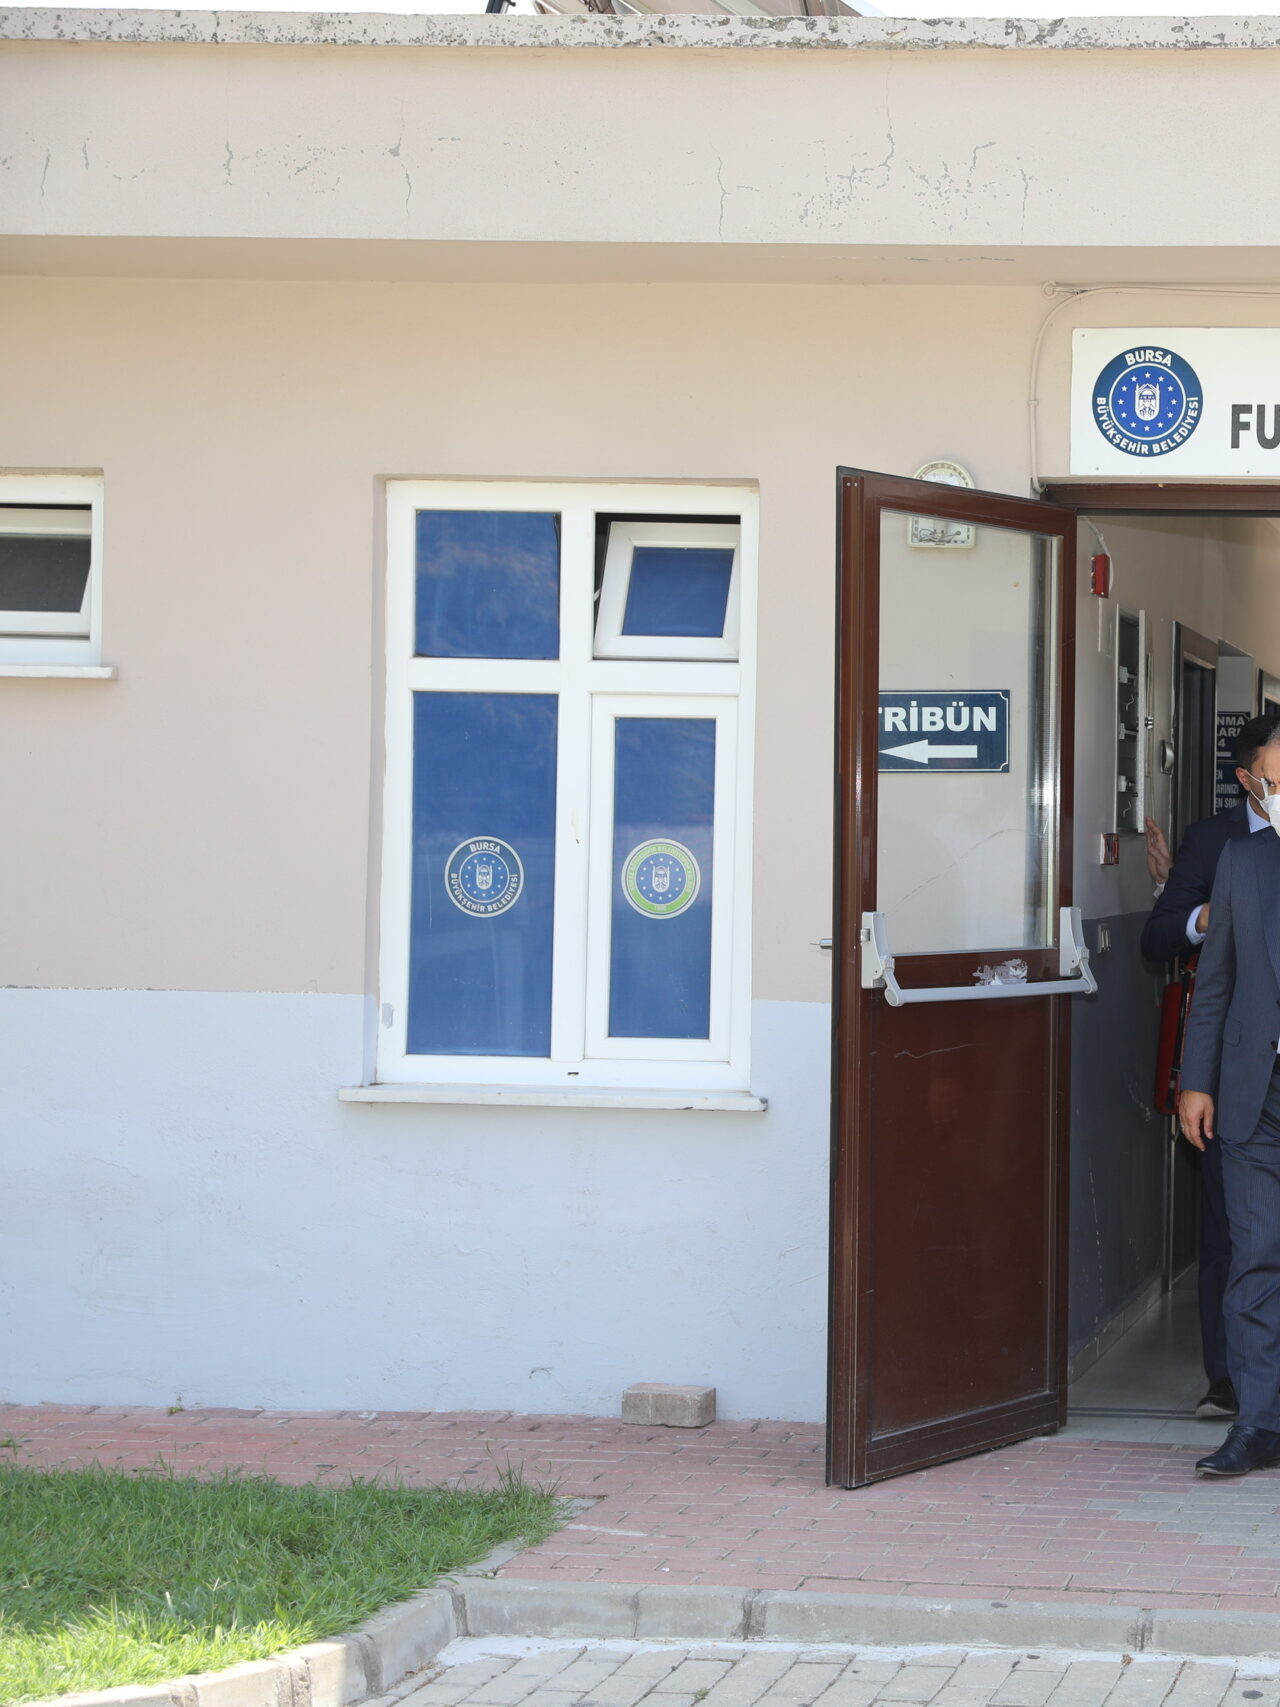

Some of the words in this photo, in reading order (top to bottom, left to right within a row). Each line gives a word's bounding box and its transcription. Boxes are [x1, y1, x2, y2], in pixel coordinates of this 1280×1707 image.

[1125, 350, 1172, 366] BURSA
[1096, 397, 1148, 454] BÜYÜKŞEHİR
[1152, 396, 1199, 454] BELEDİYESİ
[469, 842, 500, 854] BURSA
[451, 873, 485, 912] BÜYÜKŞEHİR
[487, 874, 518, 912] BELEDİYESİ
